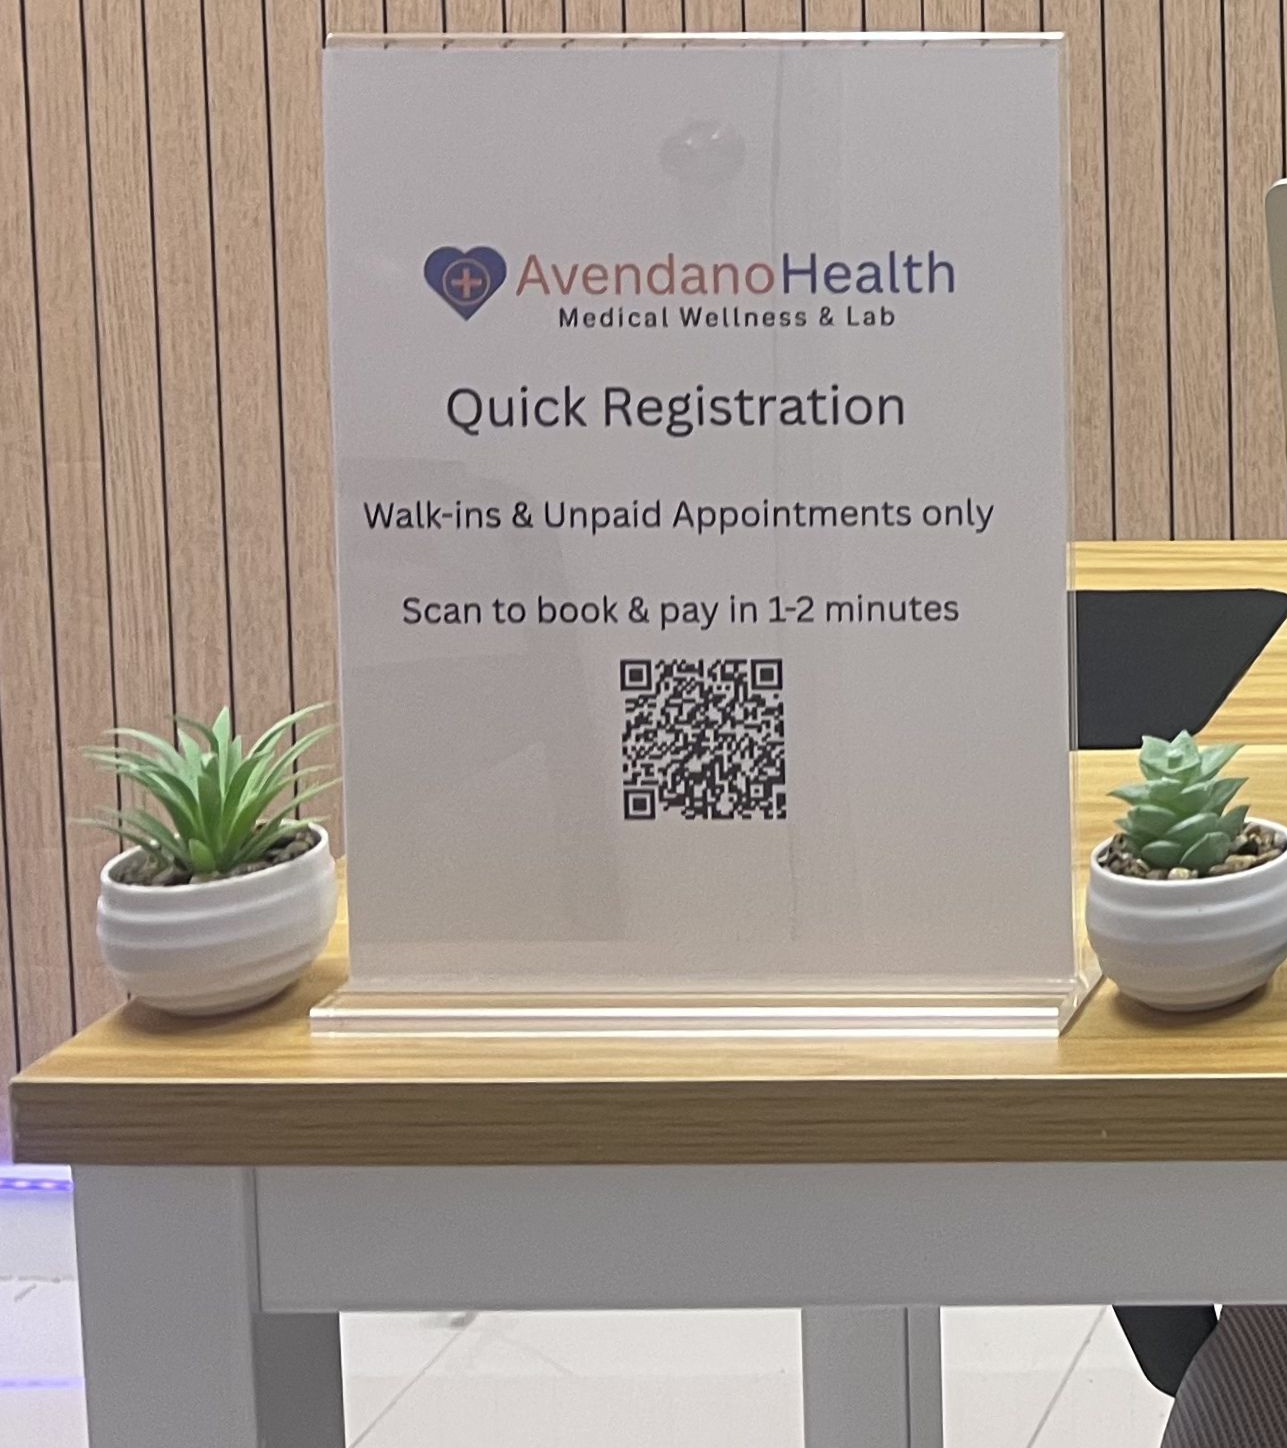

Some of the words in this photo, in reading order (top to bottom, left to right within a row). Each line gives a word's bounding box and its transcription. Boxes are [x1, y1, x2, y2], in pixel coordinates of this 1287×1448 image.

[559, 307, 668, 328] Medical
[680, 307, 806, 327] Wellness
[819, 306, 833, 326] &
[848, 306, 894, 326] Lab
[447, 386, 587, 436] Quick
[605, 384, 903, 437] Registration
[364, 500, 501, 529] Walk-ins
[512, 501, 533, 528] &
[545, 500, 660, 536] Unpaid
[673, 499, 911, 535] Appointments
[923, 497, 994, 533] only
[403, 597, 481, 624] Scan
[492, 599, 526, 624] to
[538, 595, 618, 624] book
[629, 596, 649, 623] &
[661, 602, 718, 631] pay
[730, 595, 757, 623] in
[769, 596, 814, 623] 1-2
[826, 594, 959, 622] minutes
